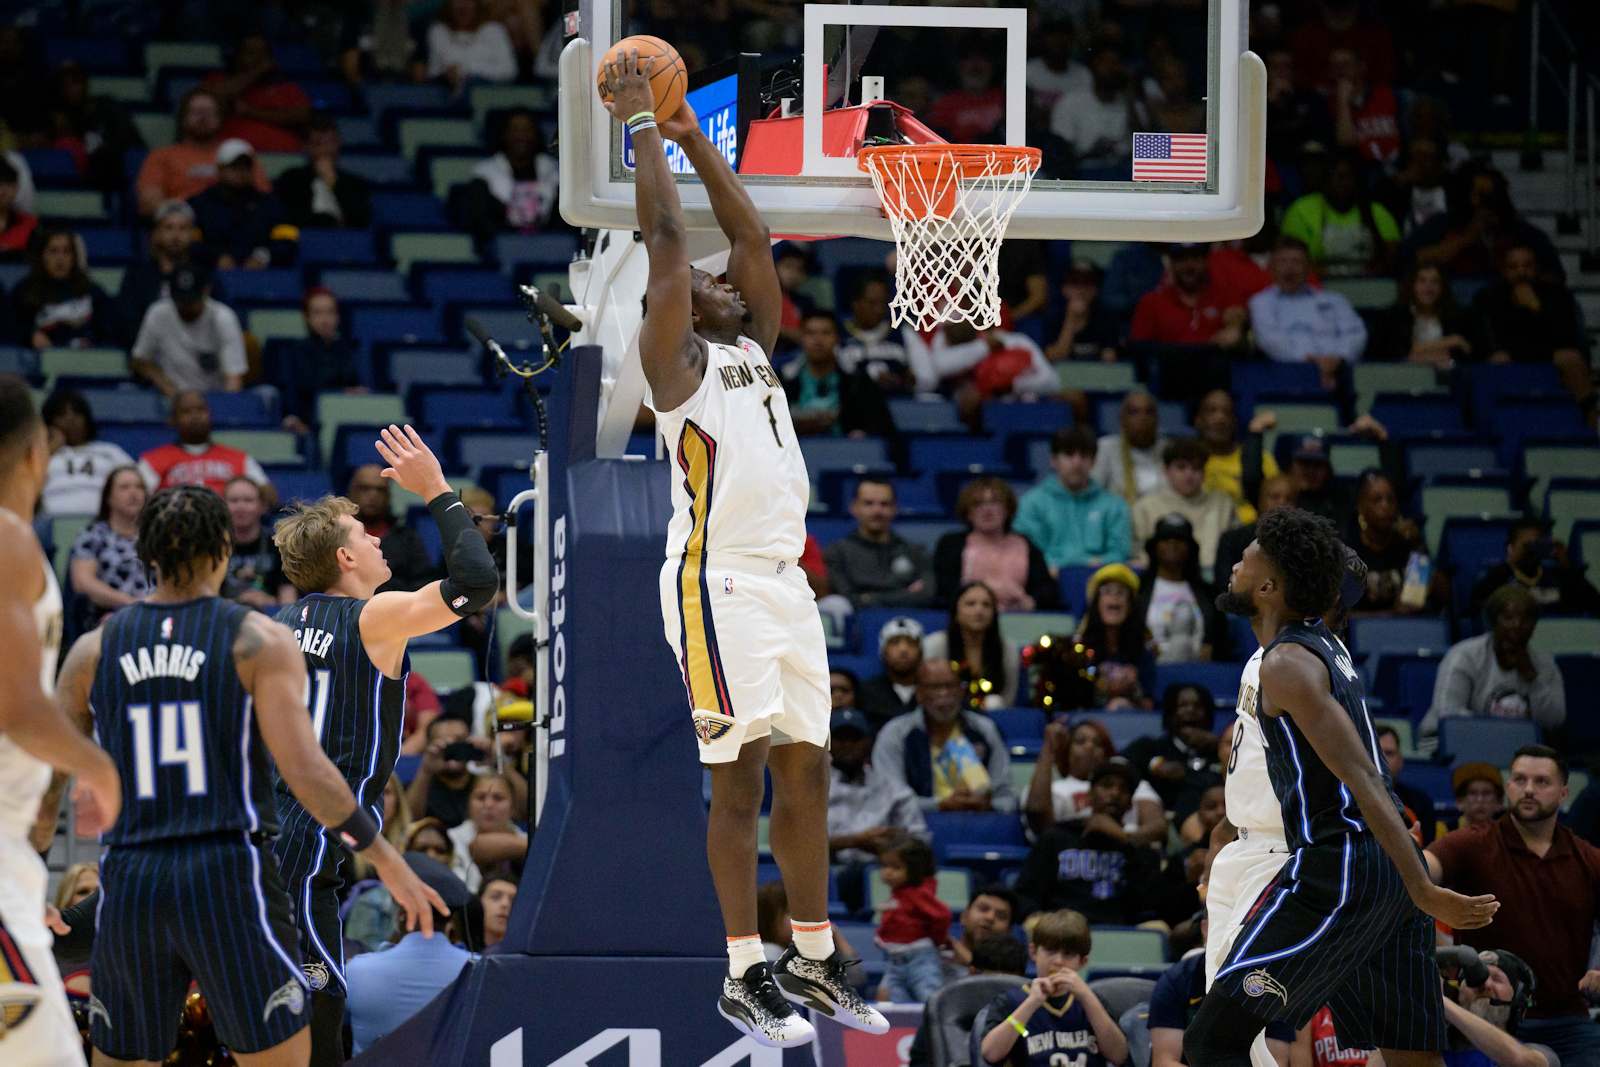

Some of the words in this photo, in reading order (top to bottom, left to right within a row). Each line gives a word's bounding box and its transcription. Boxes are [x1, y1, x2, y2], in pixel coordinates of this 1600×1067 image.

[718, 360, 754, 391] NEW
[763, 394, 784, 449] 1
[119, 643, 206, 686] HARRIS
[126, 701, 208, 799] 14
[1027, 1030, 1054, 1055] NEW
